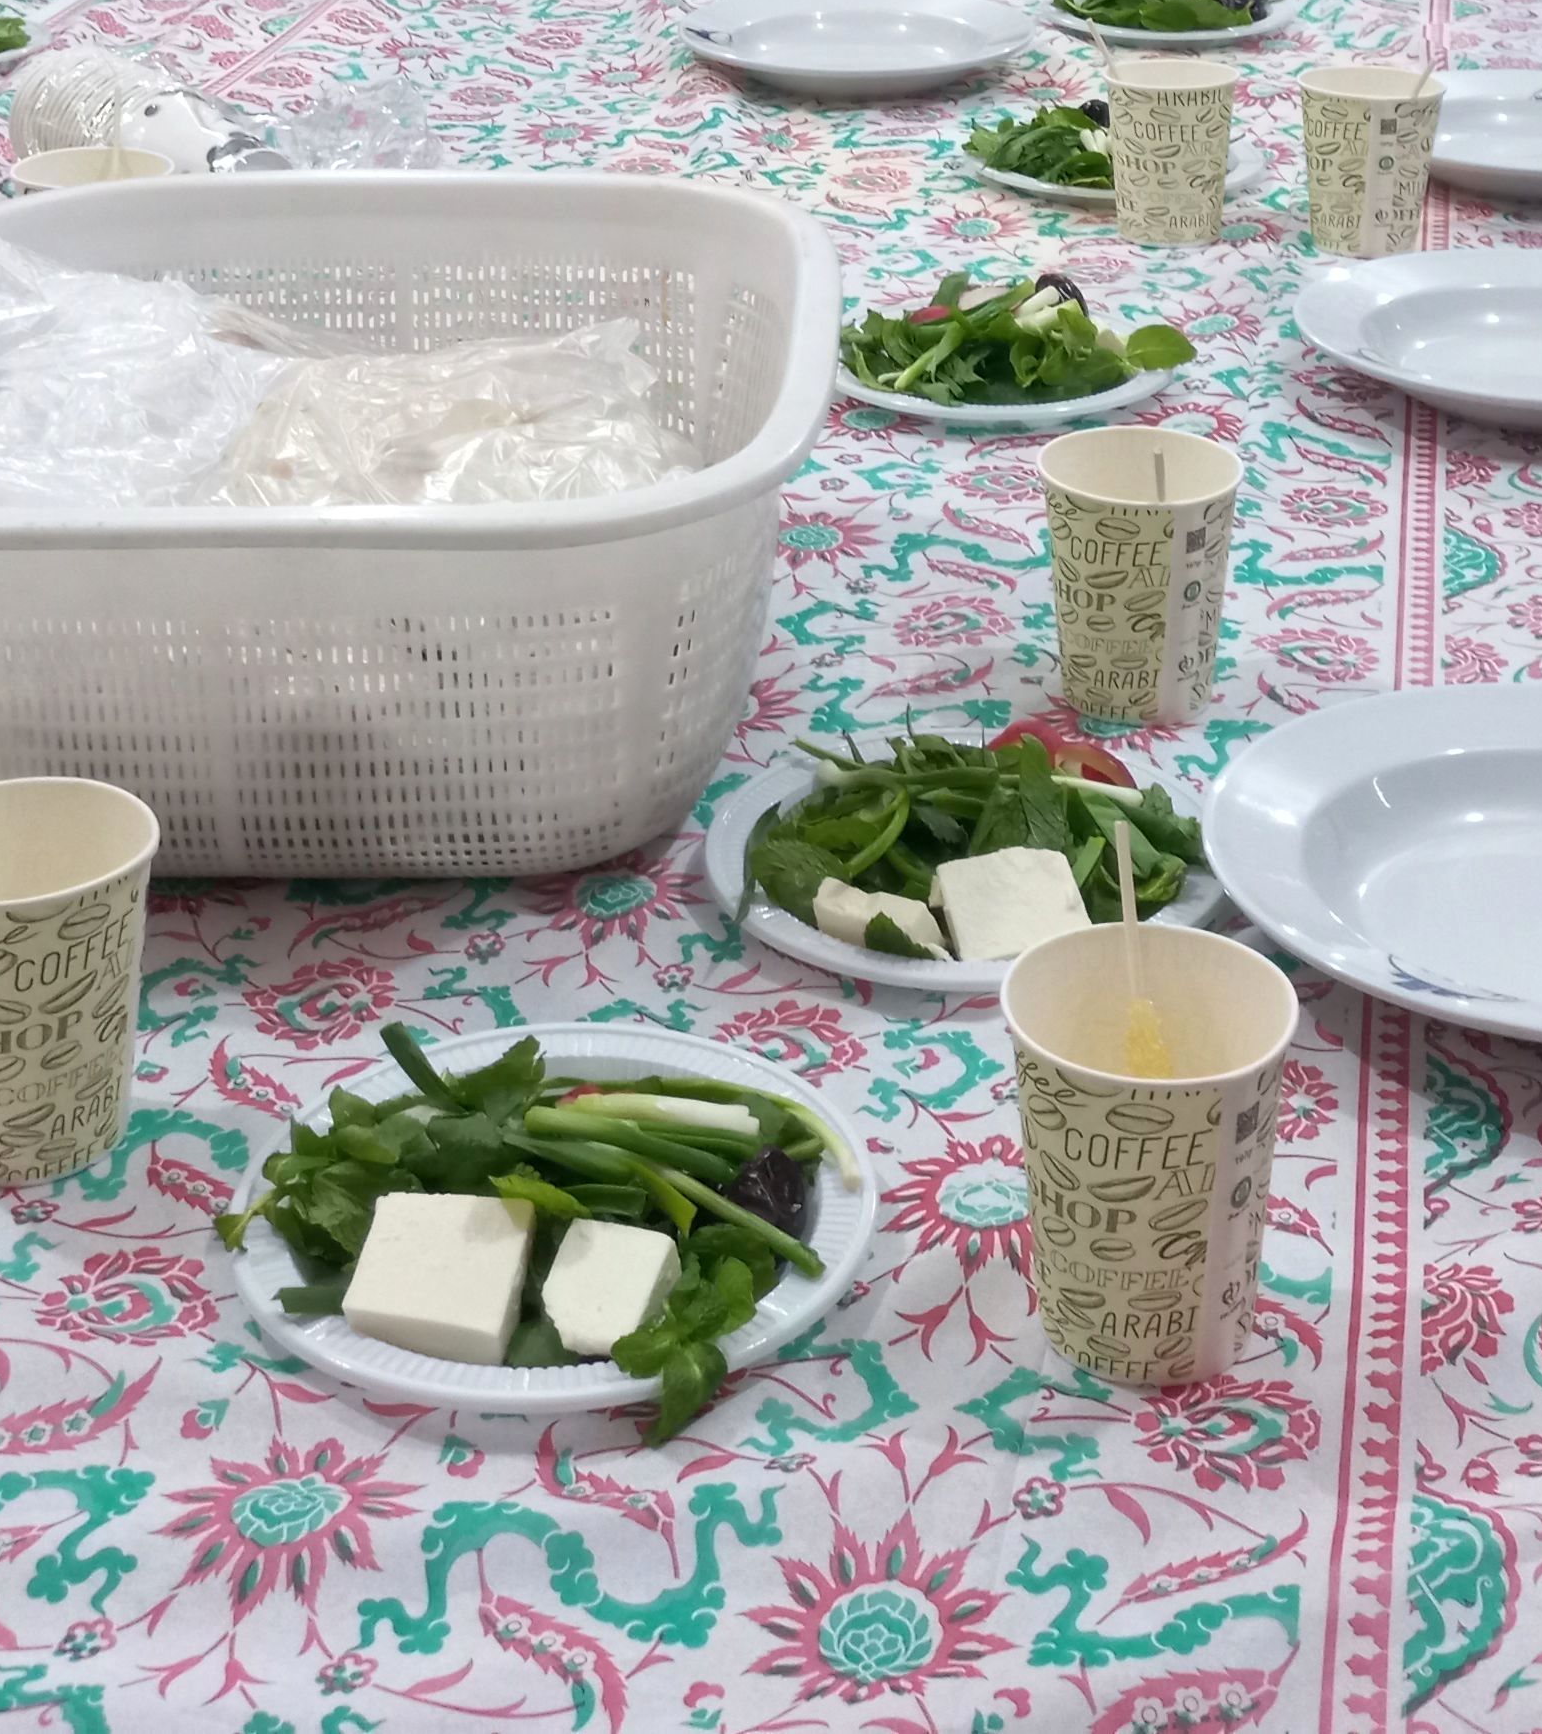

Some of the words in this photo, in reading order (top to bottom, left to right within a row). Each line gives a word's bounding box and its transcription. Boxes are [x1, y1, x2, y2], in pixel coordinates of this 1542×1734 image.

[1133, 121, 1201, 143] COFFEE
[1308, 121, 1368, 141] COFFEE
[1117, 151, 1176, 174] SHOP
[1070, 536, 1168, 567] COFFEE
[1057, 578, 1116, 612] HOP
[15, 908, 134, 992] COFFEE
[1065, 1128, 1213, 1171] COFFEE
[1050, 1250, 1192, 1292] COFFEE
